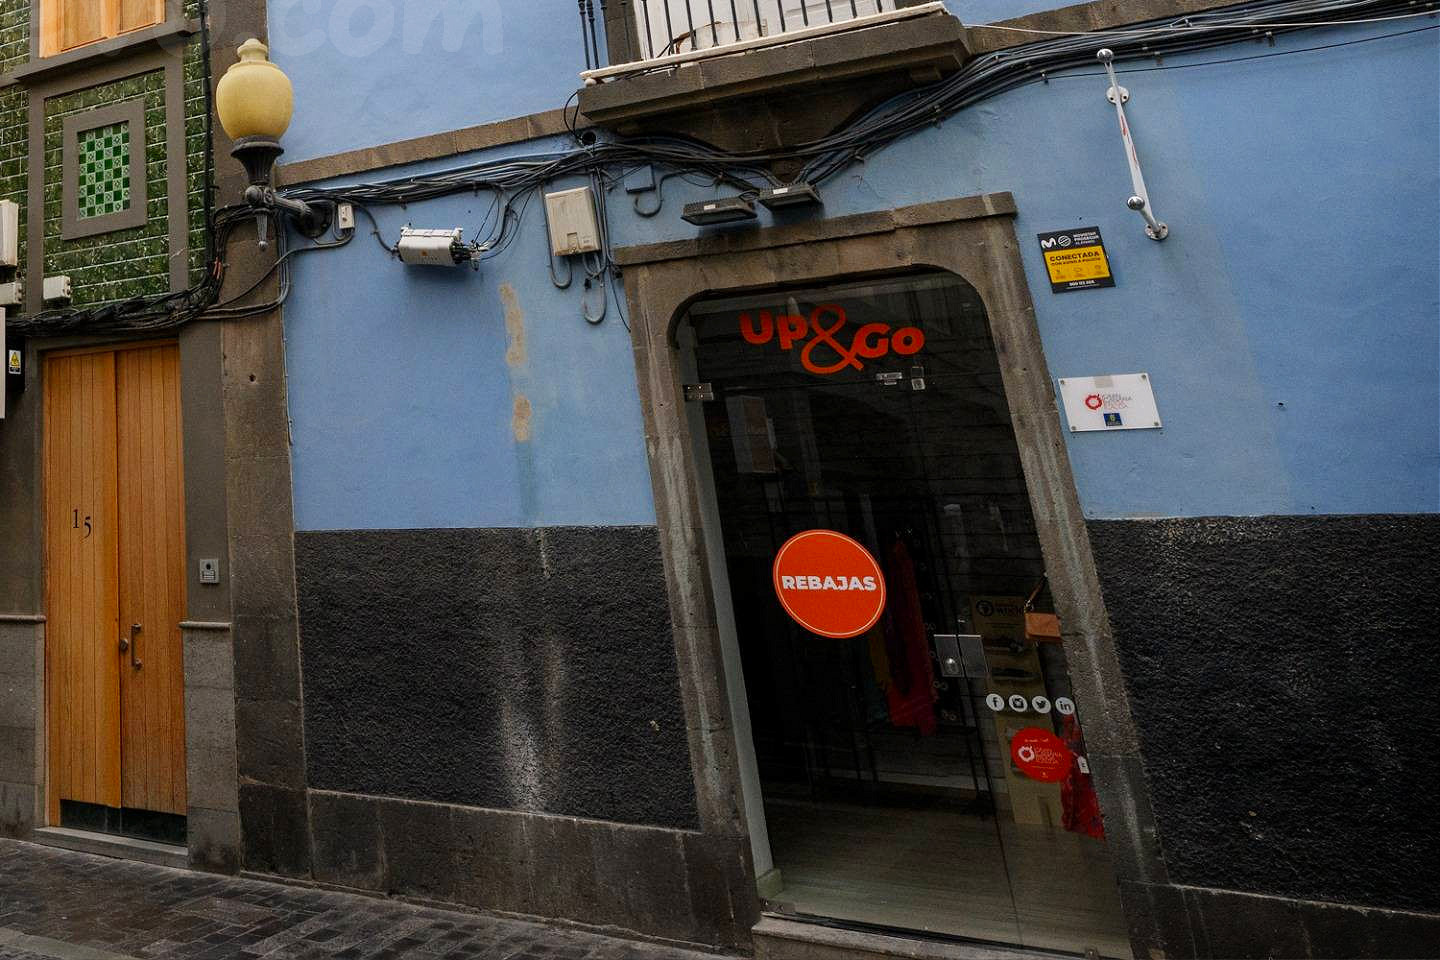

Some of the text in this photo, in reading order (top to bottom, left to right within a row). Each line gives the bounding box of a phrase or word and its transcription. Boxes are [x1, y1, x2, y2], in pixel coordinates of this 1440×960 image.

[1049, 251, 1100, 262] CONECTADA
[72, 508, 92, 539] 15
[781, 574, 878, 592] REBAJAS
